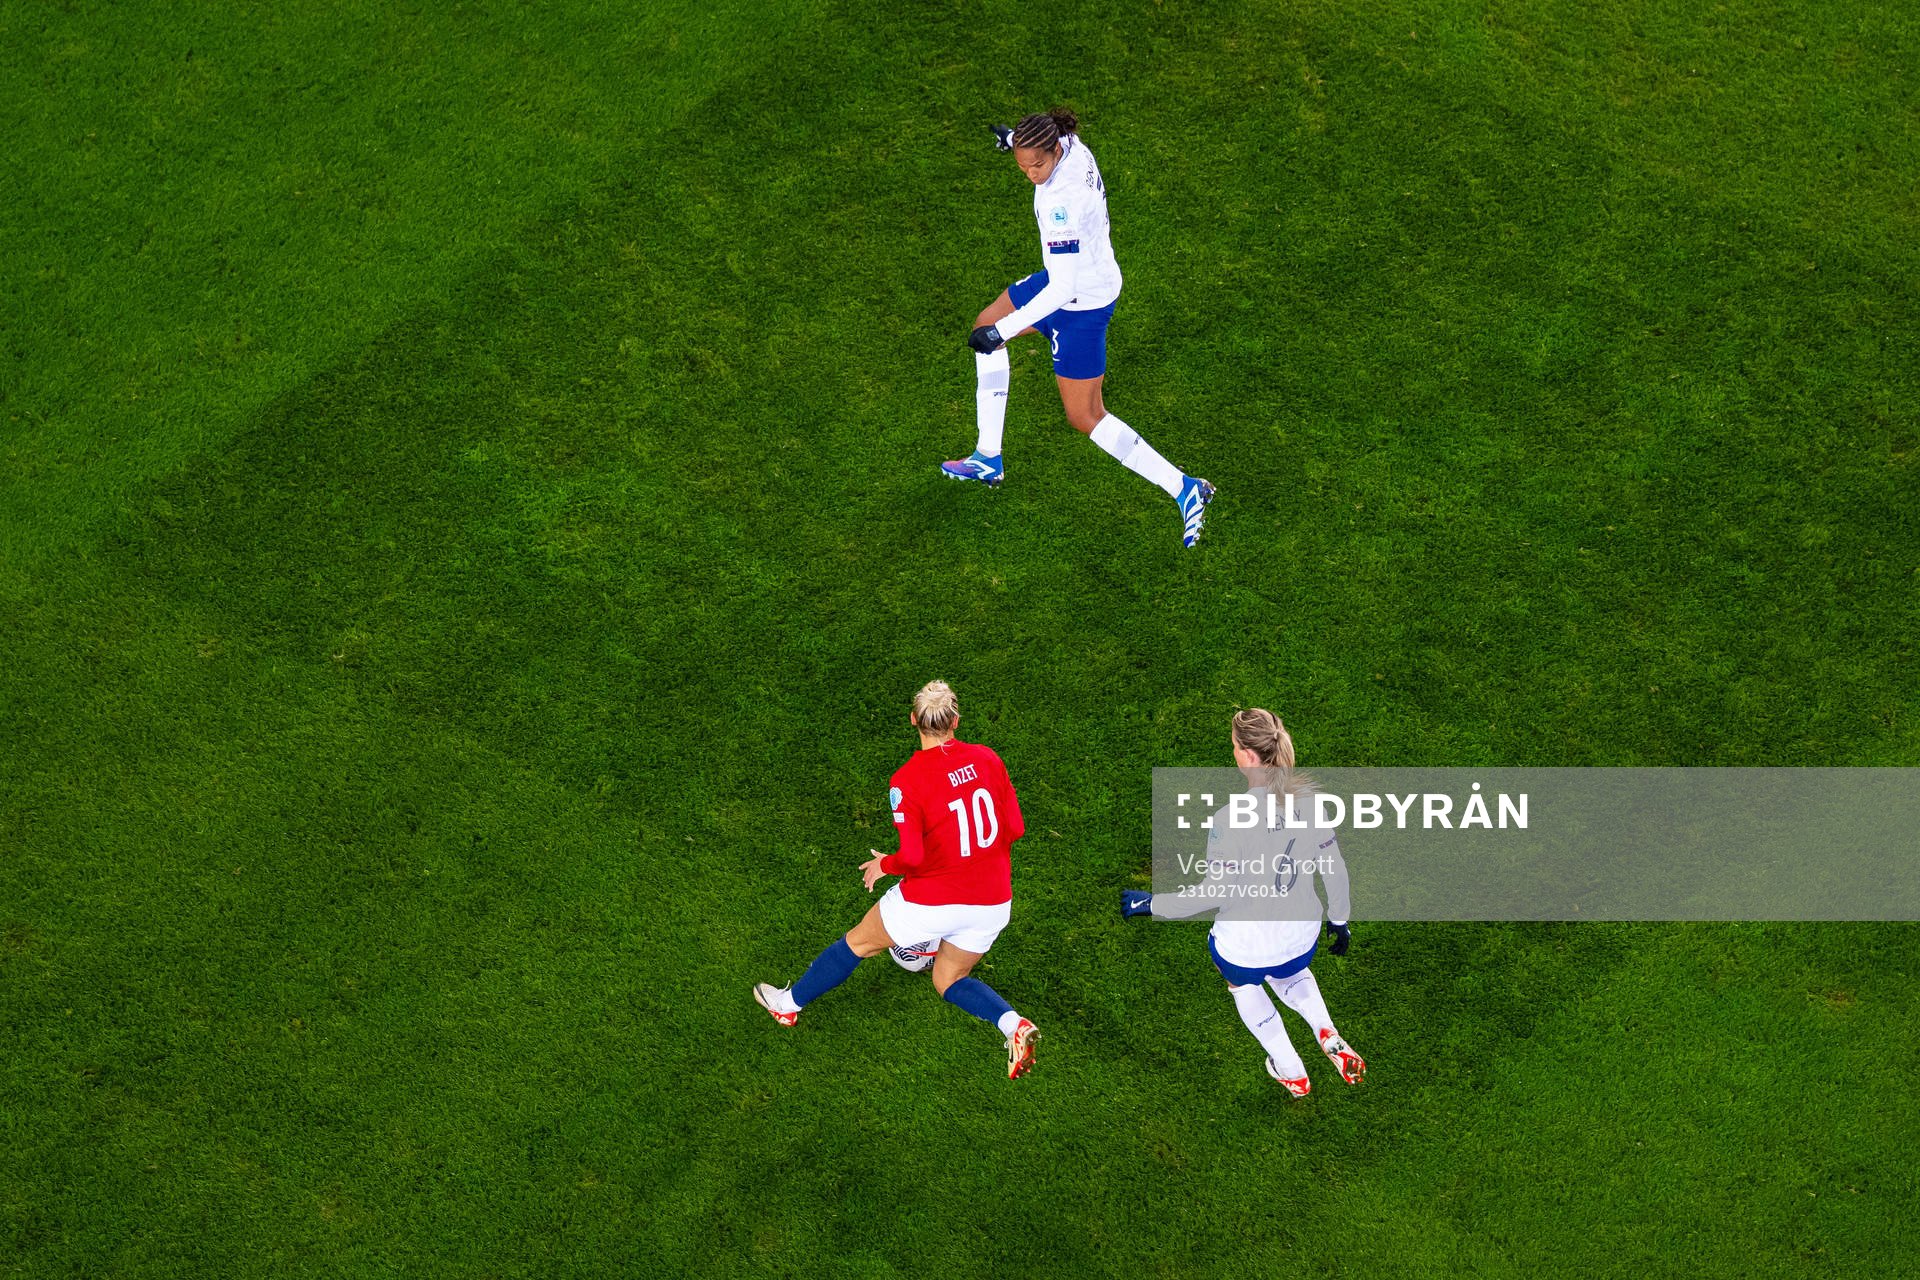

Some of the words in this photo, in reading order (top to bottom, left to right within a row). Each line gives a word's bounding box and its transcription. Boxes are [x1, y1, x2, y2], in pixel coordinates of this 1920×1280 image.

[947, 763, 978, 788] BIZET
[947, 788, 999, 857] 10
[1275, 838, 1298, 893] 6
